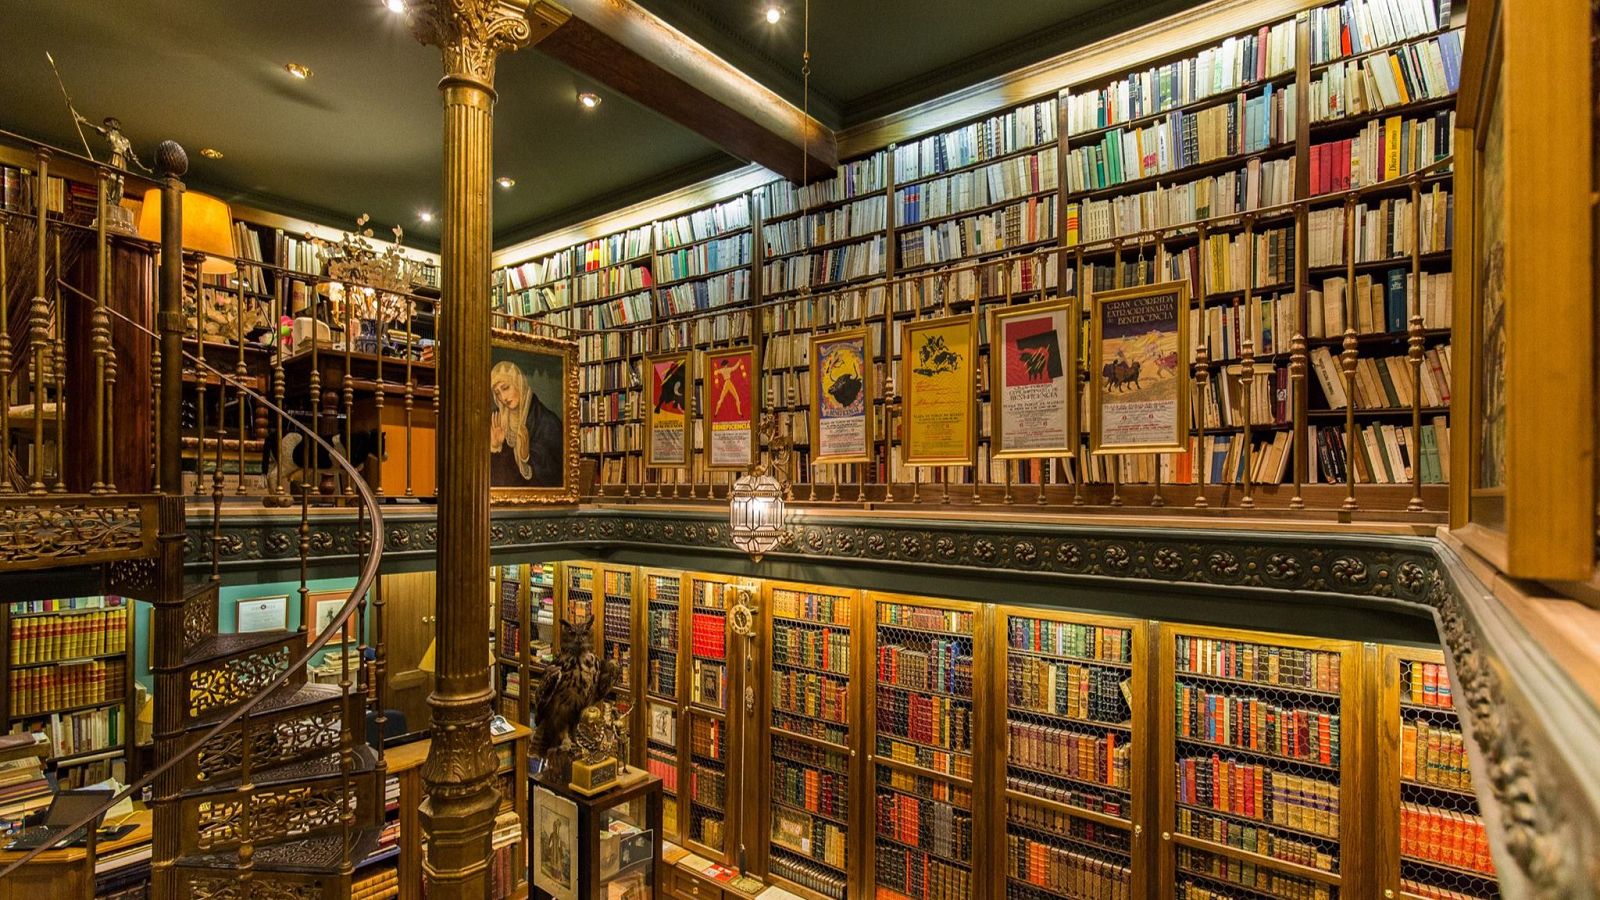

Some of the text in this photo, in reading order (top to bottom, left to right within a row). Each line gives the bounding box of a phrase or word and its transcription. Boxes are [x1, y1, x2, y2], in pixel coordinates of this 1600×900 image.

[1389, 151, 1397, 172] Diario
[1107, 296, 1174, 310] GRAN CORRIDA
[1107, 303, 1174, 317] EXTRAORDINARIA
[1118, 312, 1173, 325] BENEFICENCIA
[712, 423, 750, 431] BENEFICENCIA
